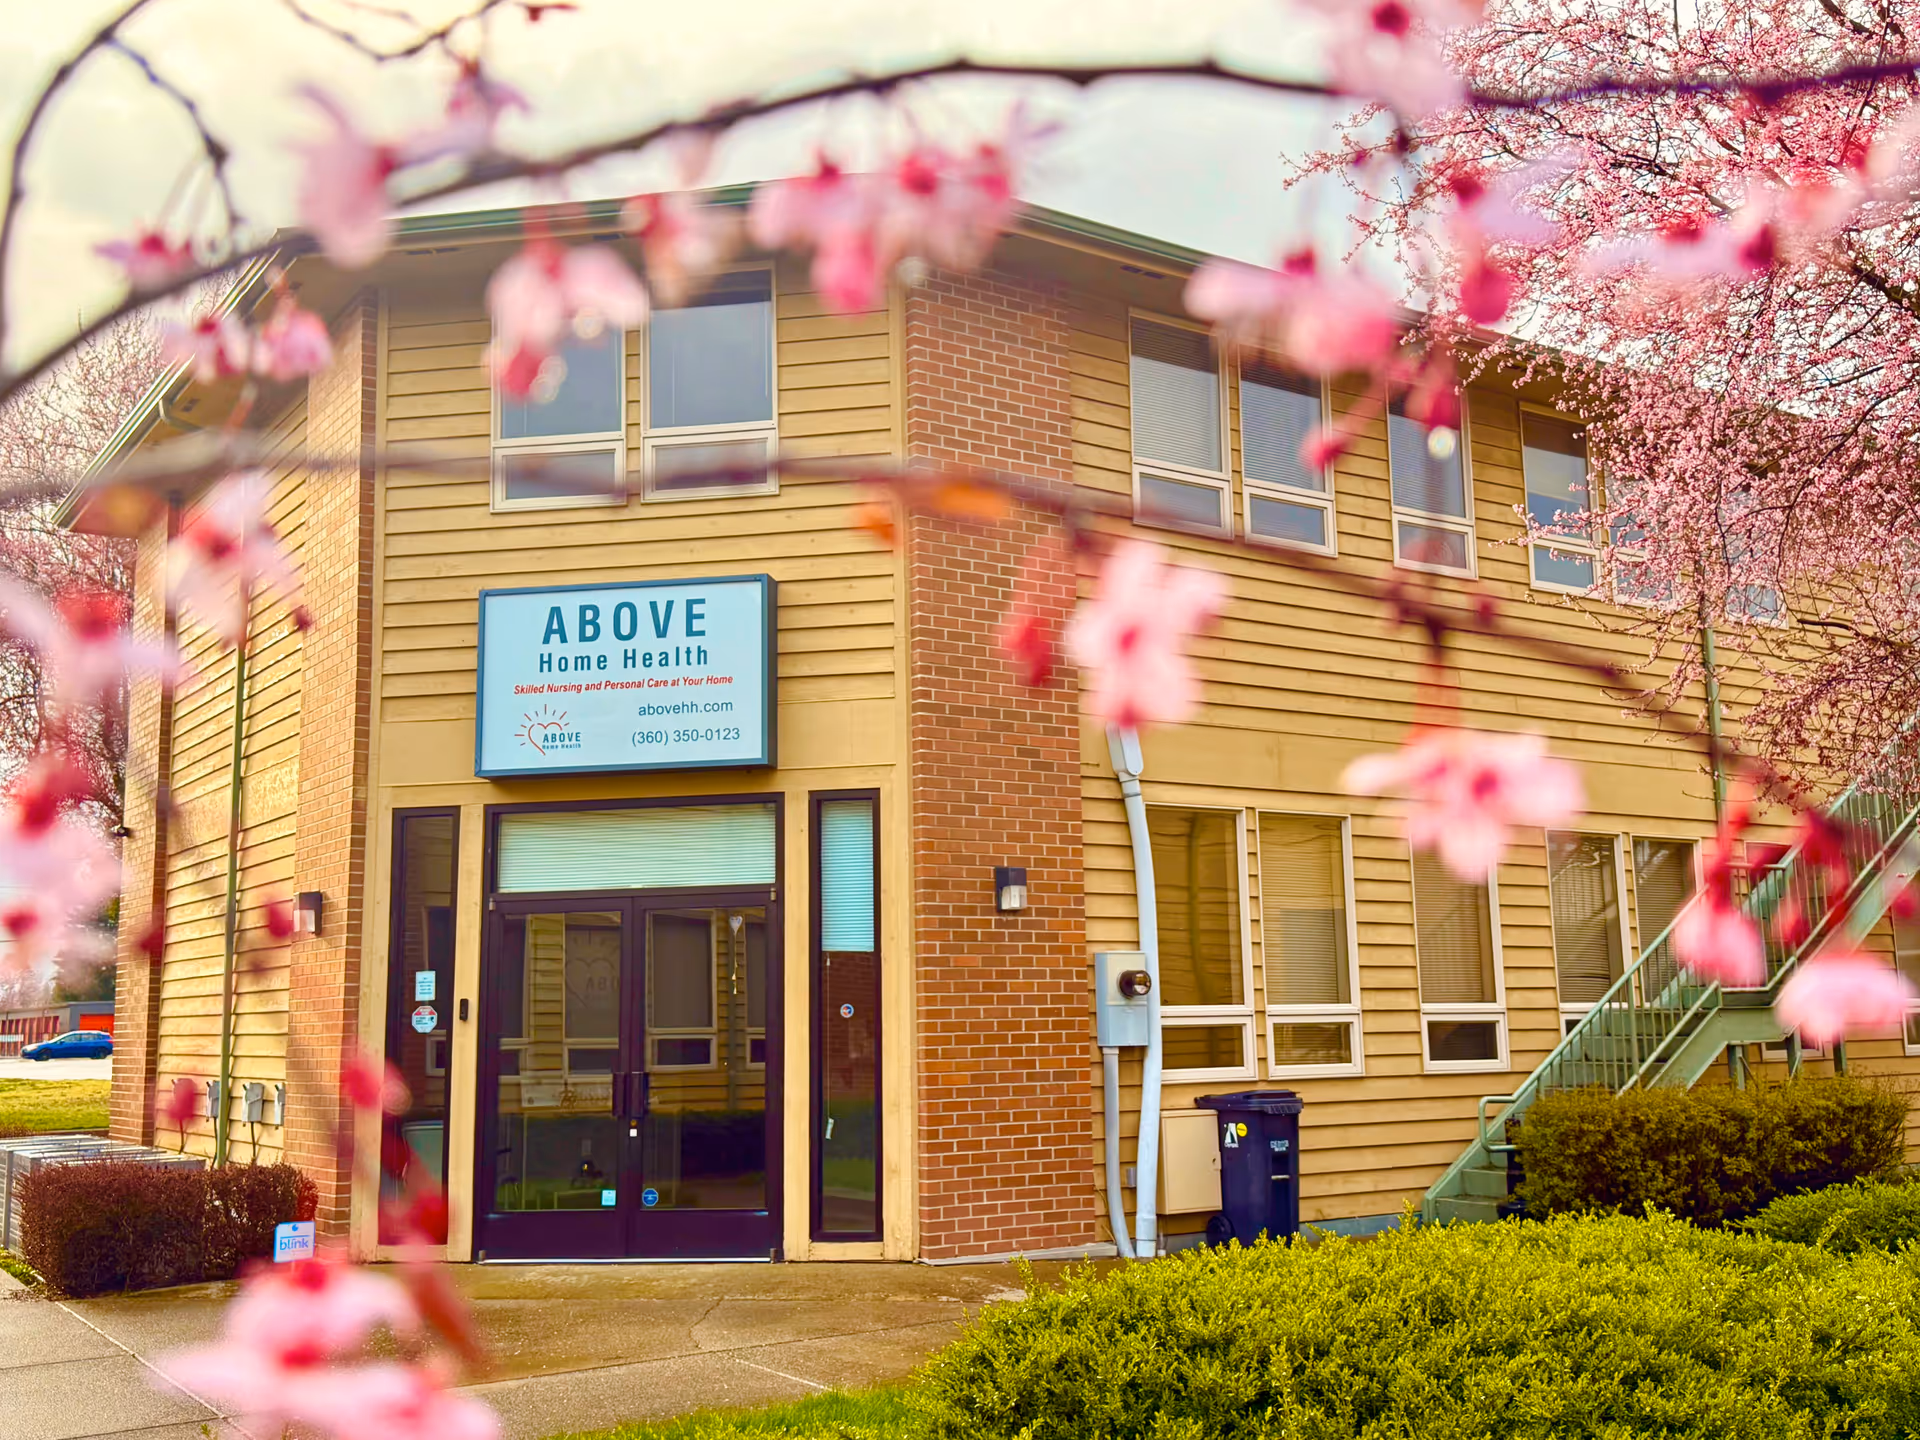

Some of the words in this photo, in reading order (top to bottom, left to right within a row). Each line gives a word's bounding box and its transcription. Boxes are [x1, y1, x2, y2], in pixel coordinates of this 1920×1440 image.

[542, 598, 706, 645] ABOVE
[538, 652, 608, 673] Home
[623, 645, 708, 669] Health
[514, 684, 544, 695] Skilled
[547, 682, 583, 694] Nursing
[585, 681, 602, 691] and
[604, 678, 645, 690] Personal
[647, 678, 669, 688] Care
[670, 678, 680, 686] at
[682, 676, 704, 686] Your
[706, 675, 734, 684] Home
[638, 701, 733, 716] abovehh.com
[542, 732, 581, 743] ABOVE
[632, 730, 669, 747] (360)
[673, 728, 741, 744] 350-0123
[280, 1238, 308, 1250] blink
